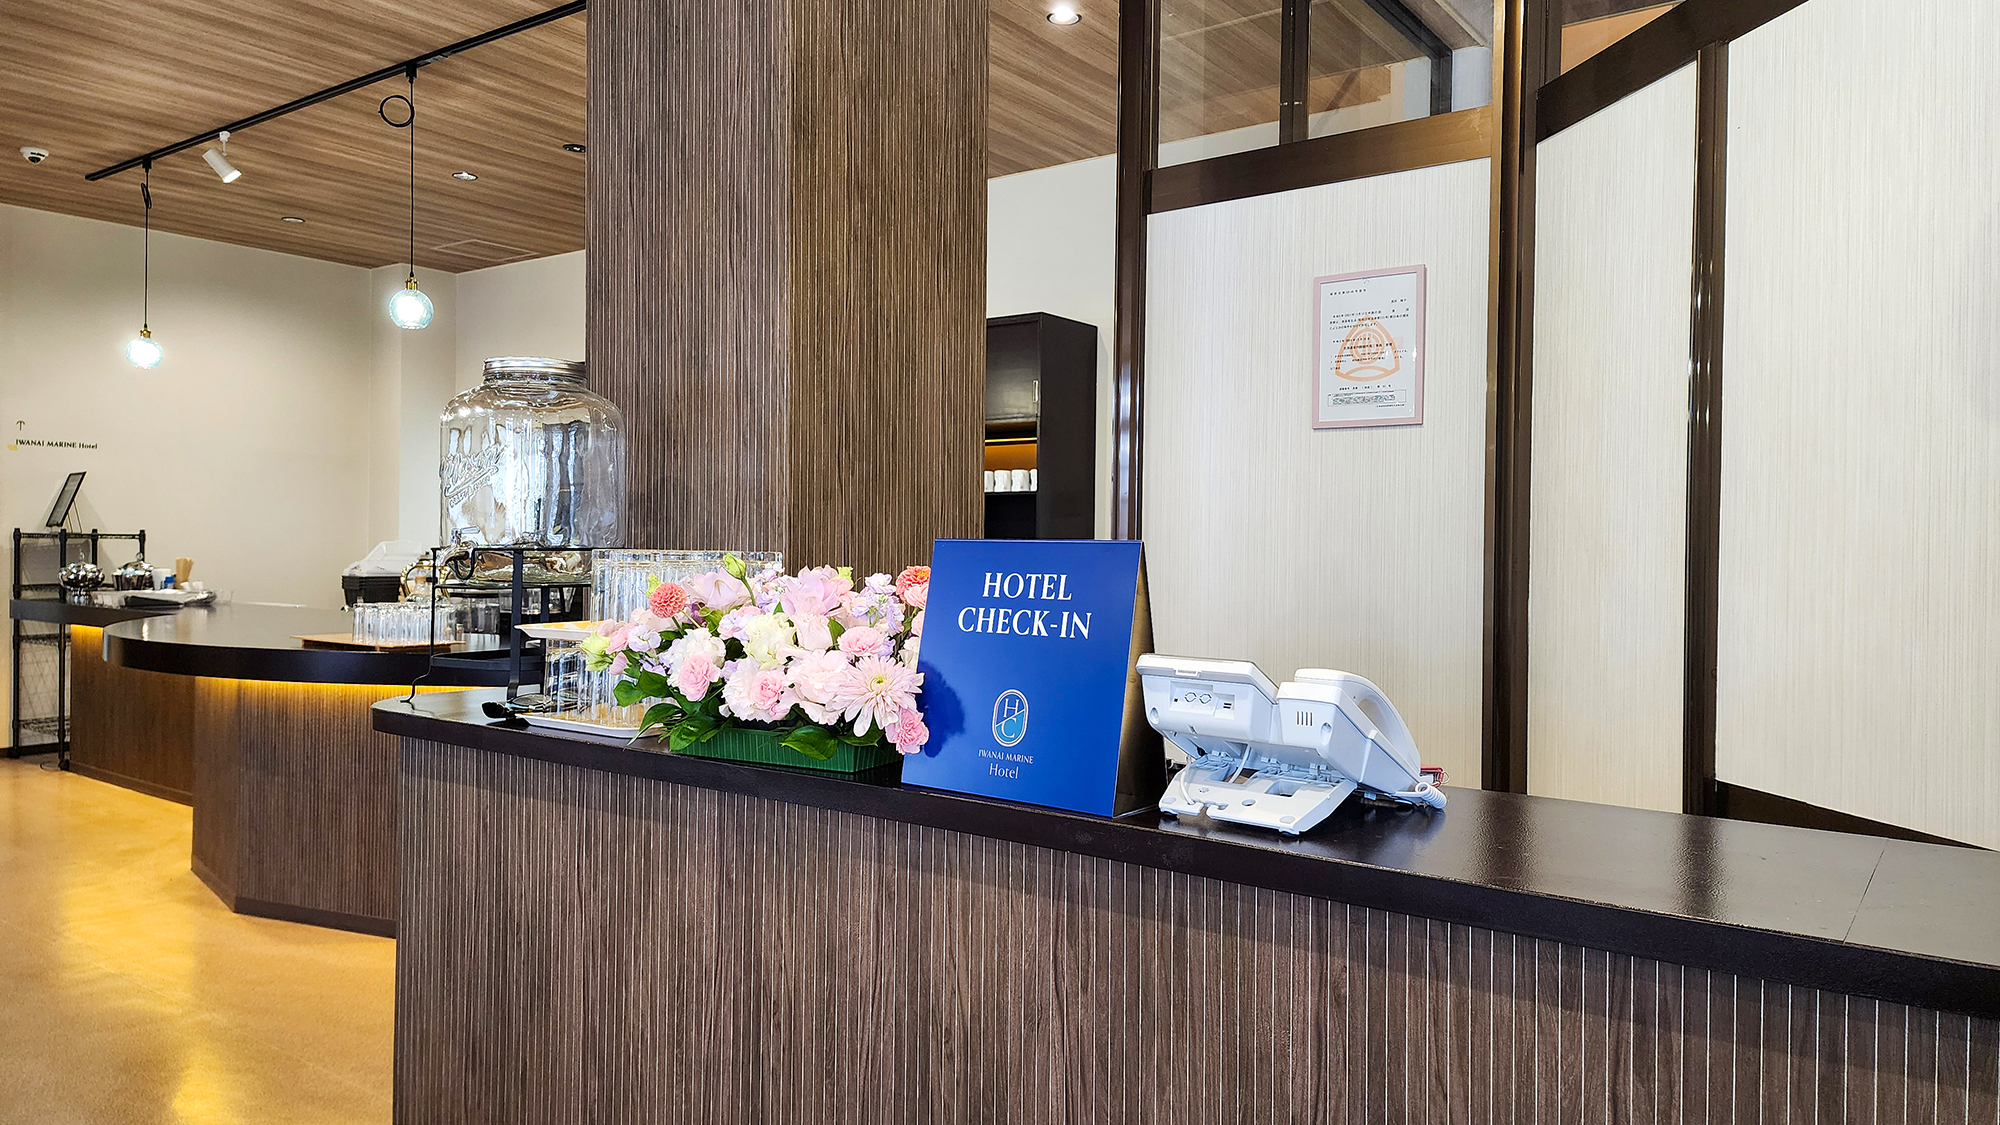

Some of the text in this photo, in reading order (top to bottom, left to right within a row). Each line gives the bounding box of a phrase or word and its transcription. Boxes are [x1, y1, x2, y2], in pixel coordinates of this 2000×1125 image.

[15, 439, 45, 447] IWANAI
[46, 441, 77, 449] MARINE
[982, 572, 1072, 601] HOTEL
[957, 607, 1092, 640] CHECK-IN
[978, 749, 1034, 765] IWANAI MARINE
[989, 763, 1019, 780] Hotel
